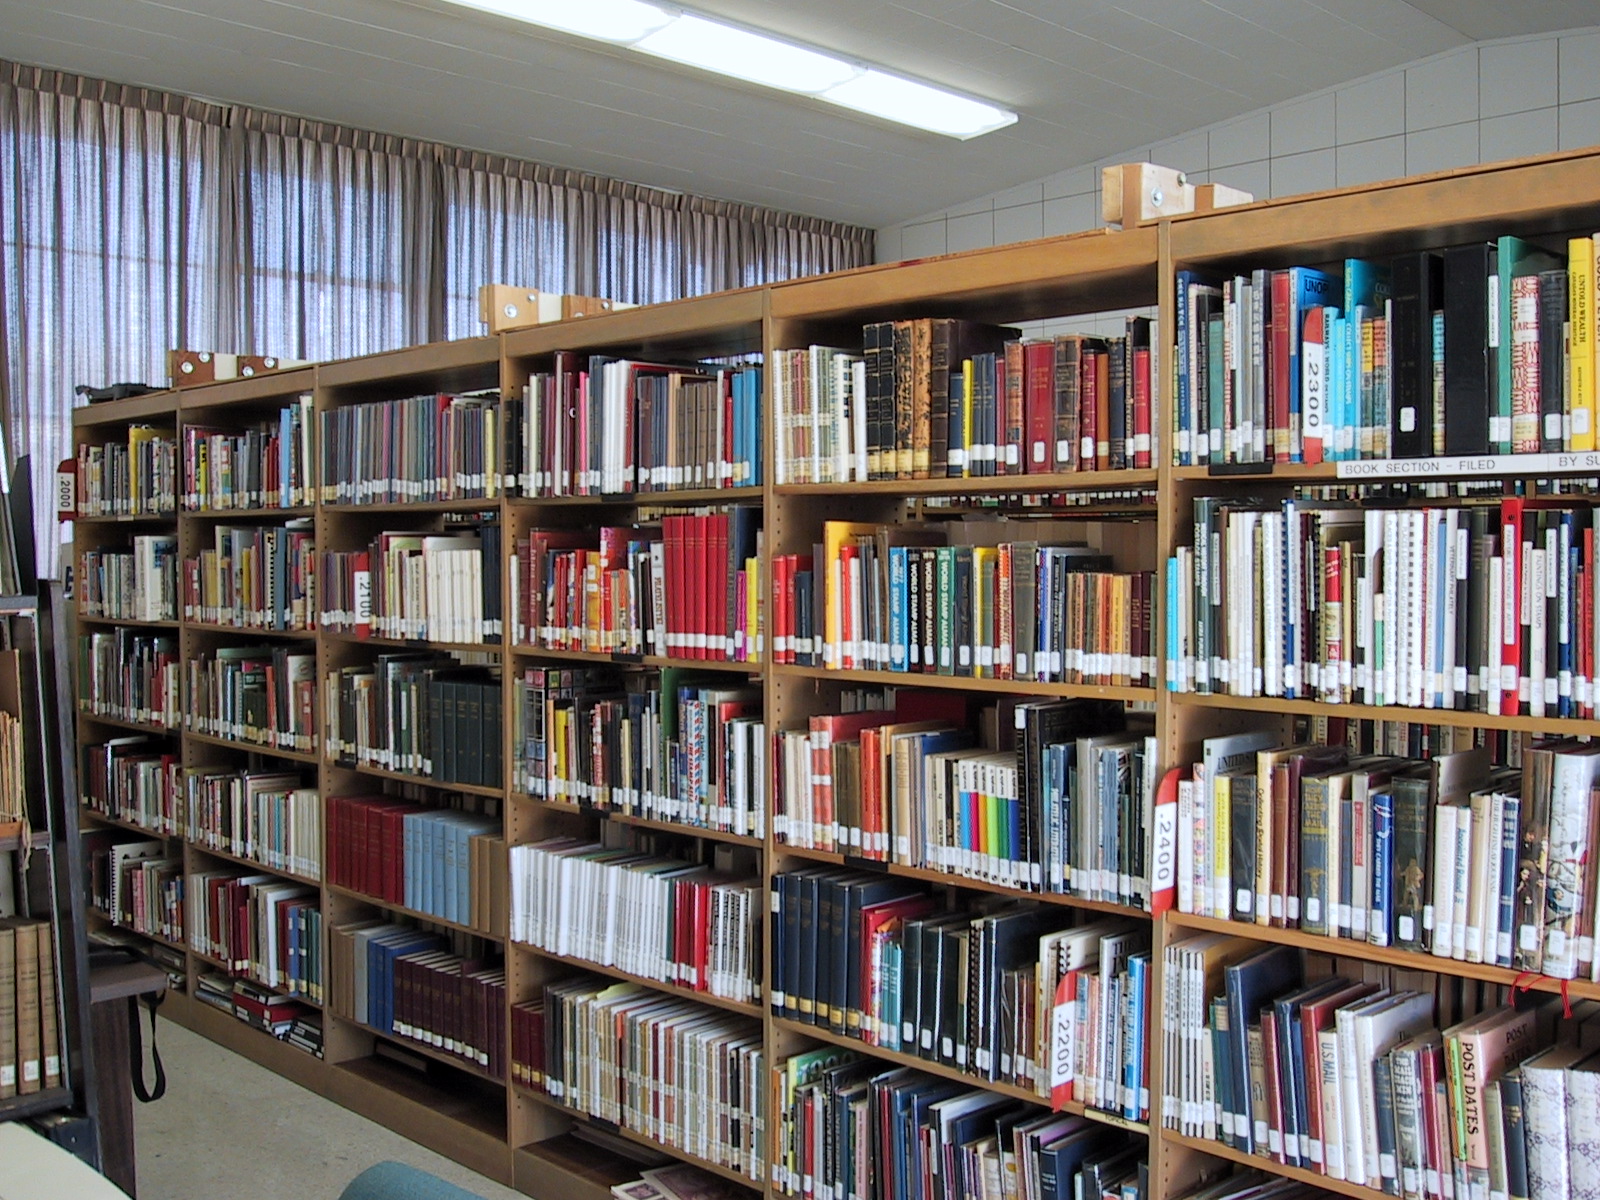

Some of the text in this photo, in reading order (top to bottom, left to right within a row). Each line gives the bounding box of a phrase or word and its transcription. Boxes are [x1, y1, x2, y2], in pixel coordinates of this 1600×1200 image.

[1308, 353, 1320, 427] .2300
[1346, 464, 1379, 474] BOOK
[1386, 462, 1439, 473] SECTION
[1459, 460, 1495, 471] FILED
[1559, 456, 1577, 467] BY
[60, 477, 70, 507] .2000
[910, 563, 918, 593] WORLD
[925, 561, 933, 591] WORLD
[359, 577, 370, 618] .2100
[925, 592, 933, 618] STAMP
[941, 561, 949, 647] WORLD STAMP ALMAN
[1506, 602, 1512, 611] BY
[1536, 592, 1542, 602] ON
[1256, 788, 1265, 824] Collecting
[1305, 818, 1325, 828] MAIL
[1157, 814, 1171, 881] .2400
[1456, 828, 1466, 866] Appointed
[1256, 854, 1264, 878] History
[1455, 869, 1465, 892] Round
[1057, 1014, 1070, 1075] .2200
[1506, 1023, 1527, 1044] POST
[1462, 1042, 1479, 1135] POST DATES
